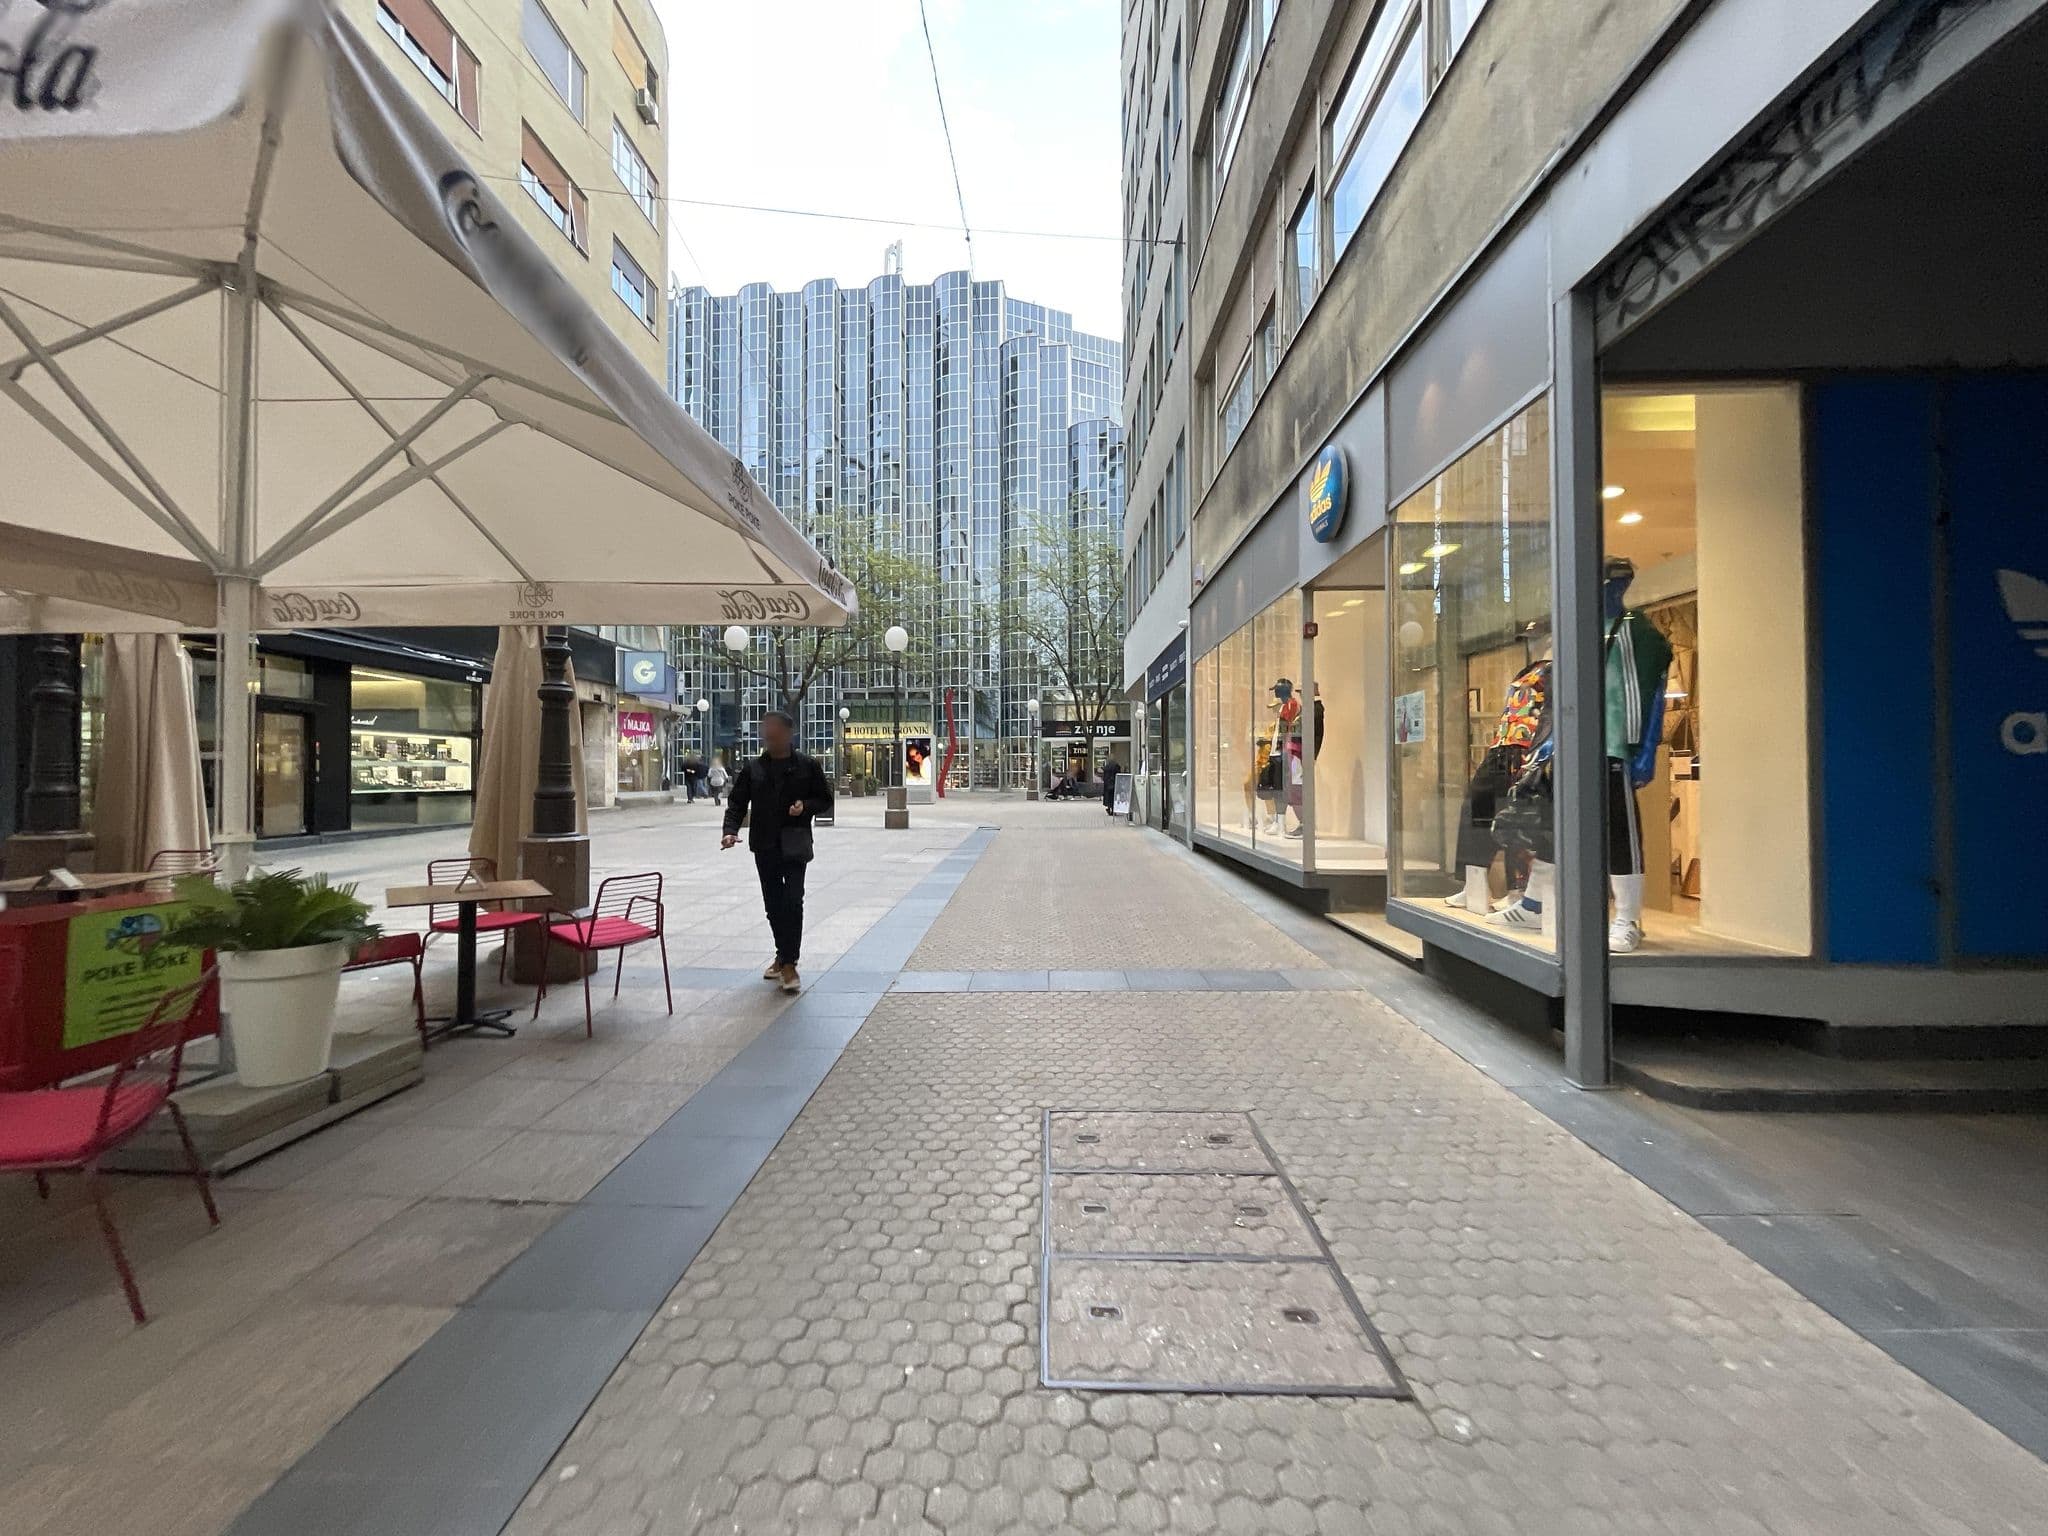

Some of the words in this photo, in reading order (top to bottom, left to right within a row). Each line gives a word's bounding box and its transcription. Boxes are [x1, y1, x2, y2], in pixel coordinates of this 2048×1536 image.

[632, 660, 657, 685] G
[854, 726, 880, 735] HOTEL
[882, 726, 928, 735] DUROVNIK
[1074, 725, 1116, 736] znje
